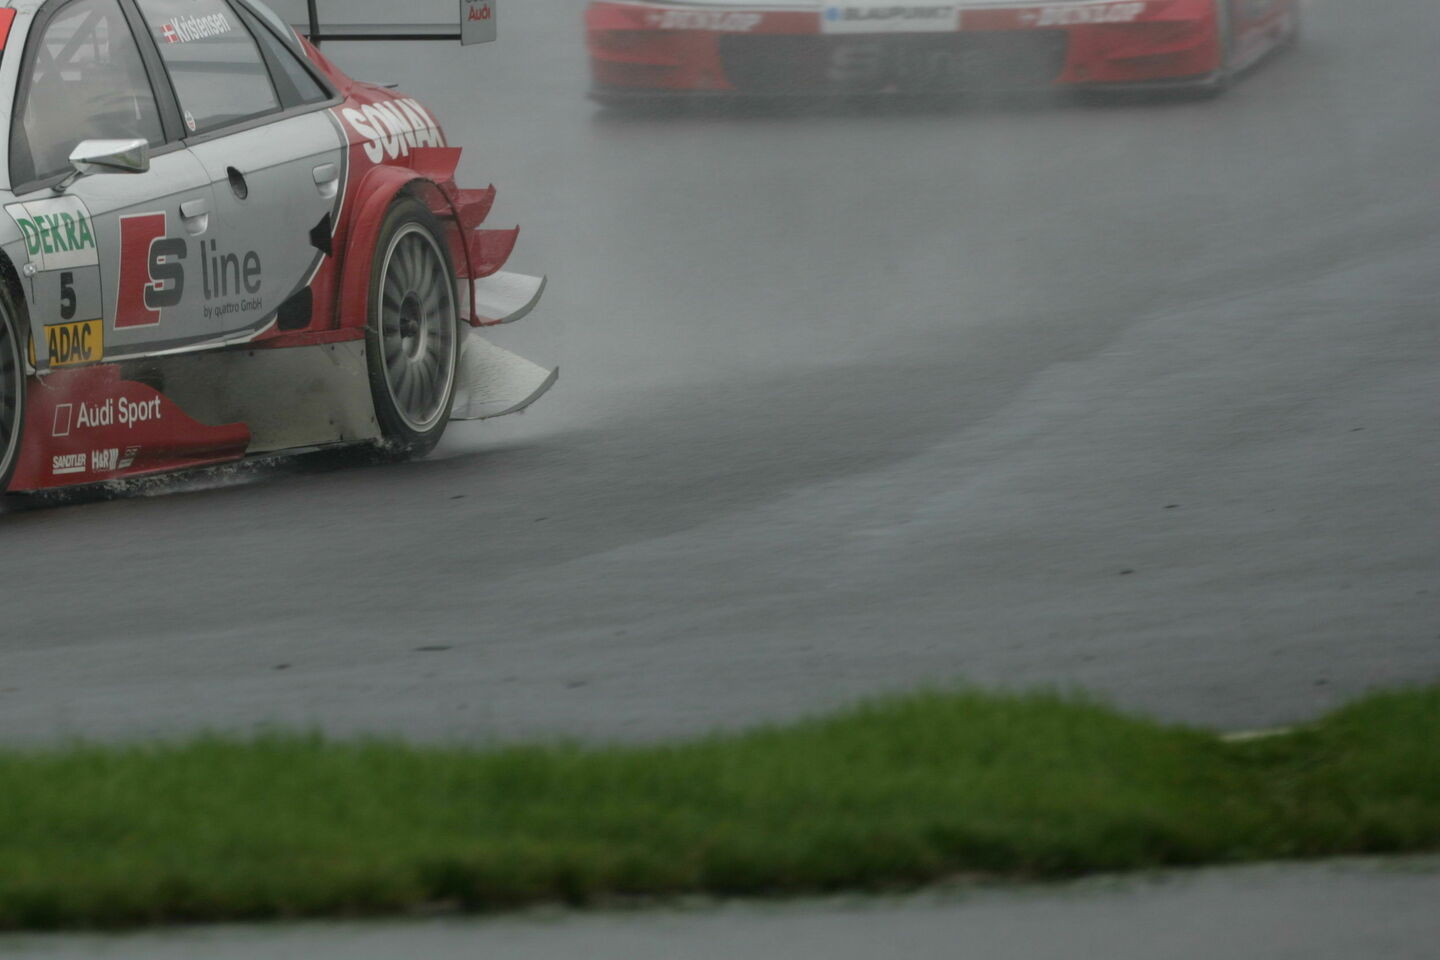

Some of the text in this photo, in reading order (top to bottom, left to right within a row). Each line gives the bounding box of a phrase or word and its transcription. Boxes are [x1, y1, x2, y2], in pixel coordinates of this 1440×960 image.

[171, 11, 232, 44] Kristensen
[468, 3, 492, 21] Audi
[342, 98, 447, 164] SONAX
[17, 209, 96, 256] DEKRA
[144, 237, 262, 309] S line
[60, 271, 78, 320] 5
[203, 297, 263, 318] by quattro GmbH
[48, 322, 92, 365] ADAC
[76, 394, 161, 430] Audi Sport
